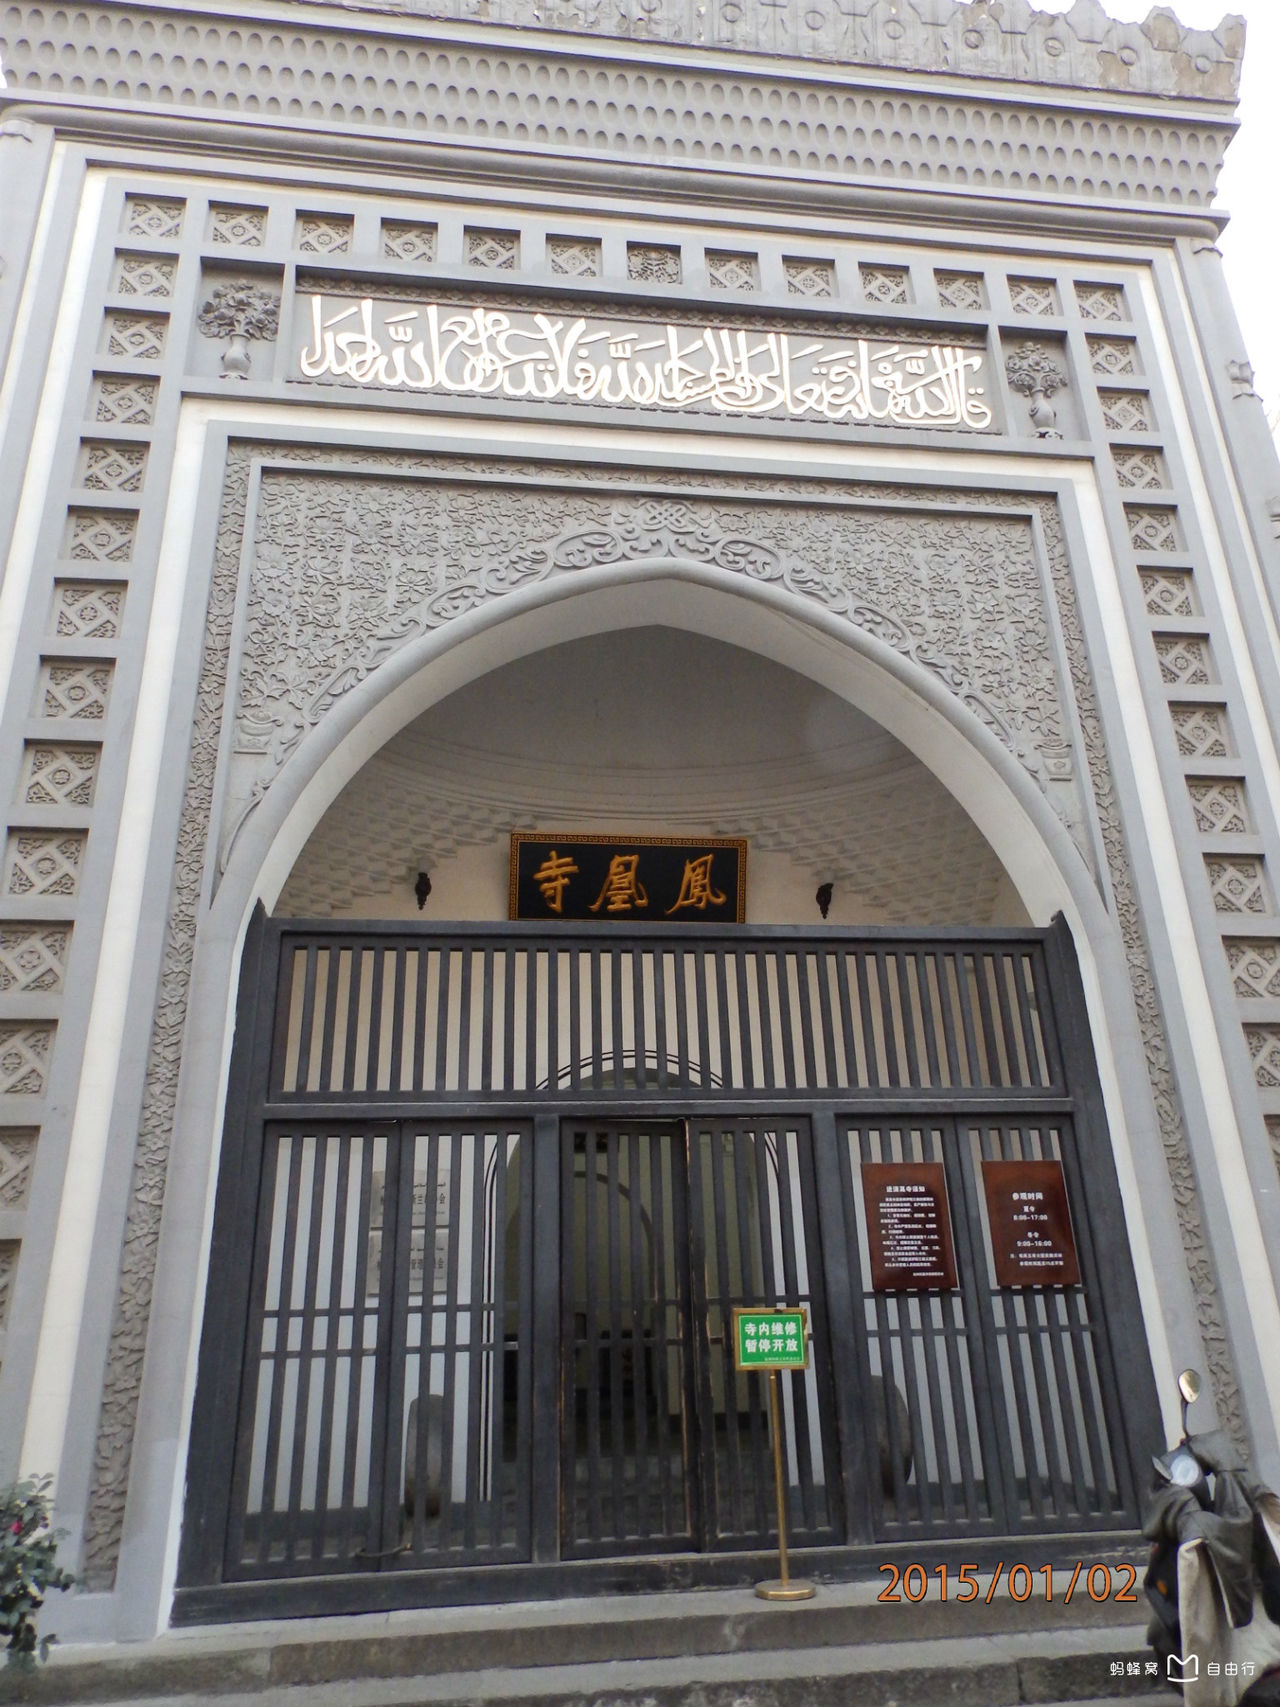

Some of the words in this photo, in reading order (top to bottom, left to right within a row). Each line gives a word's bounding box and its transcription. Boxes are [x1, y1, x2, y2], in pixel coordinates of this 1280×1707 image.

[744, 1322, 797, 1336] 寺内维修
[745, 1339, 798, 1353] 暂停开放
